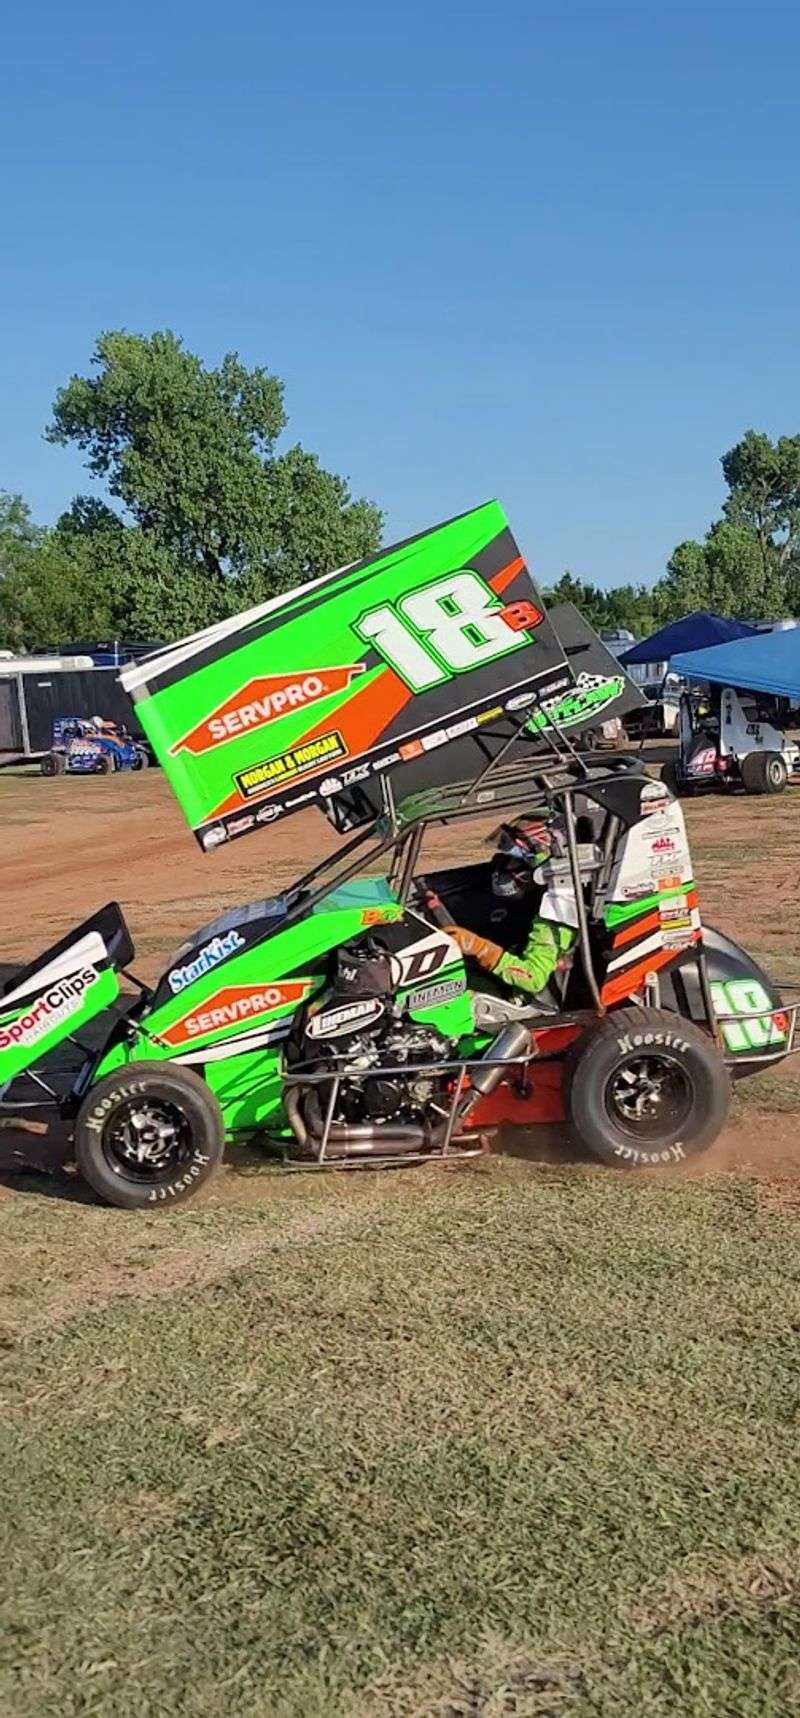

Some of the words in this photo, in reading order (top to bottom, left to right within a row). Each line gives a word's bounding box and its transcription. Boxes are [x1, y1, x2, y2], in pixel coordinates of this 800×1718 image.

[240, 760, 286, 789] MORGAN
[285, 755, 297, 769] &
[293, 735, 340, 766] MORGAN
[169, 932, 243, 992] StarKist
[184, 988, 282, 1035] SERVPRO
[617, 1031, 691, 1054] Hoosier
[86, 1081, 147, 1133] Hoosier
[148, 1148, 210, 1201] Hoosier
[614, 1142, 686, 1166] Hoosier
